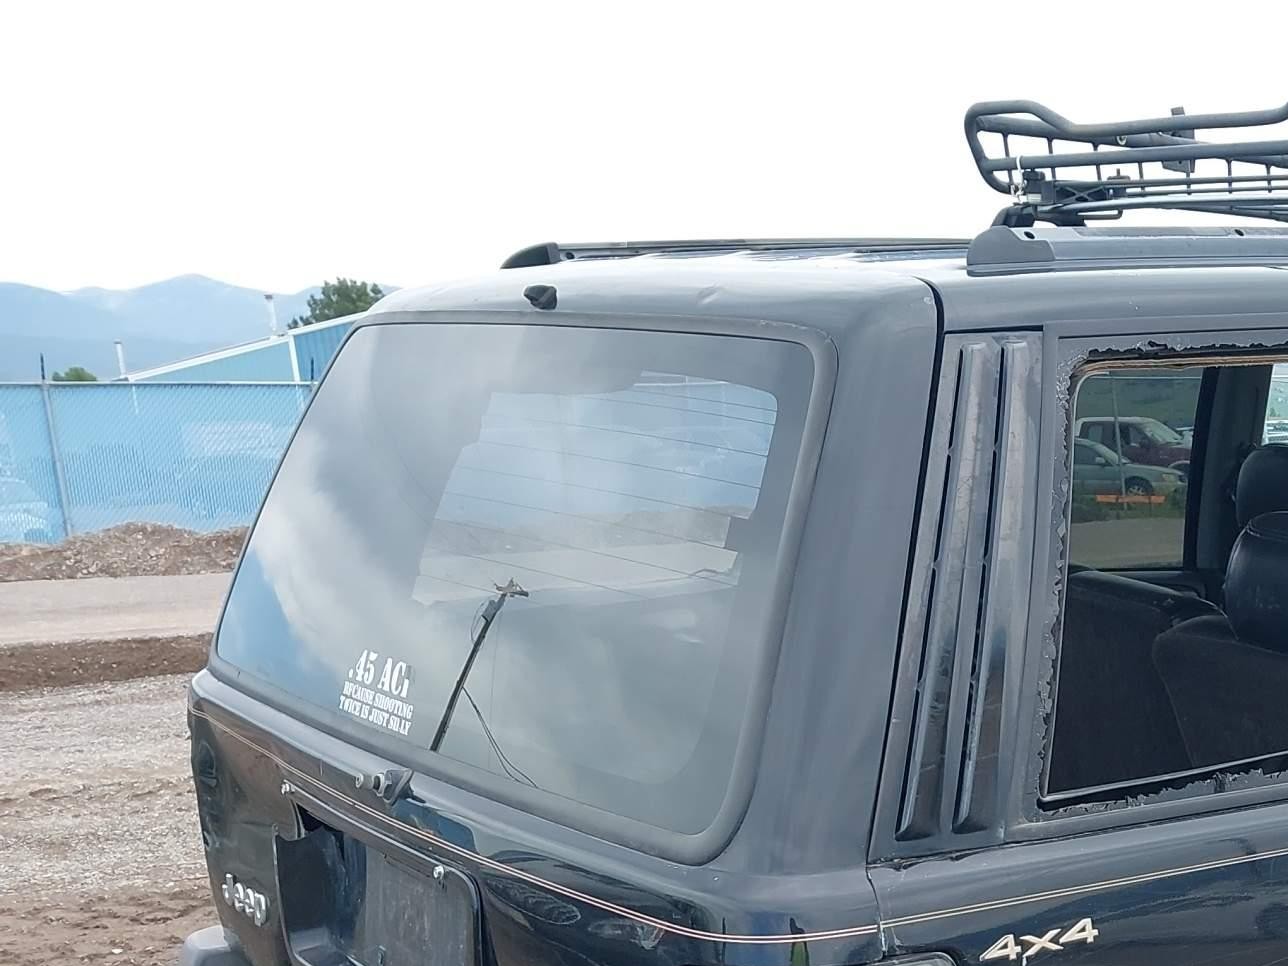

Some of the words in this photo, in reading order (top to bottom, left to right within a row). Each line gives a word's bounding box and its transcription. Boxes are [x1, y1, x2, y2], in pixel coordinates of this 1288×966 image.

[348, 649, 378, 685] .45
[338, 695, 361, 716] TWICE
[360, 704, 370, 720] IS
[368, 707, 390, 728] JUST
[388, 714, 412, 736] SILLY
[373, 692, 414, 720] SHOOTING
[221, 872, 266, 928] Jeep
